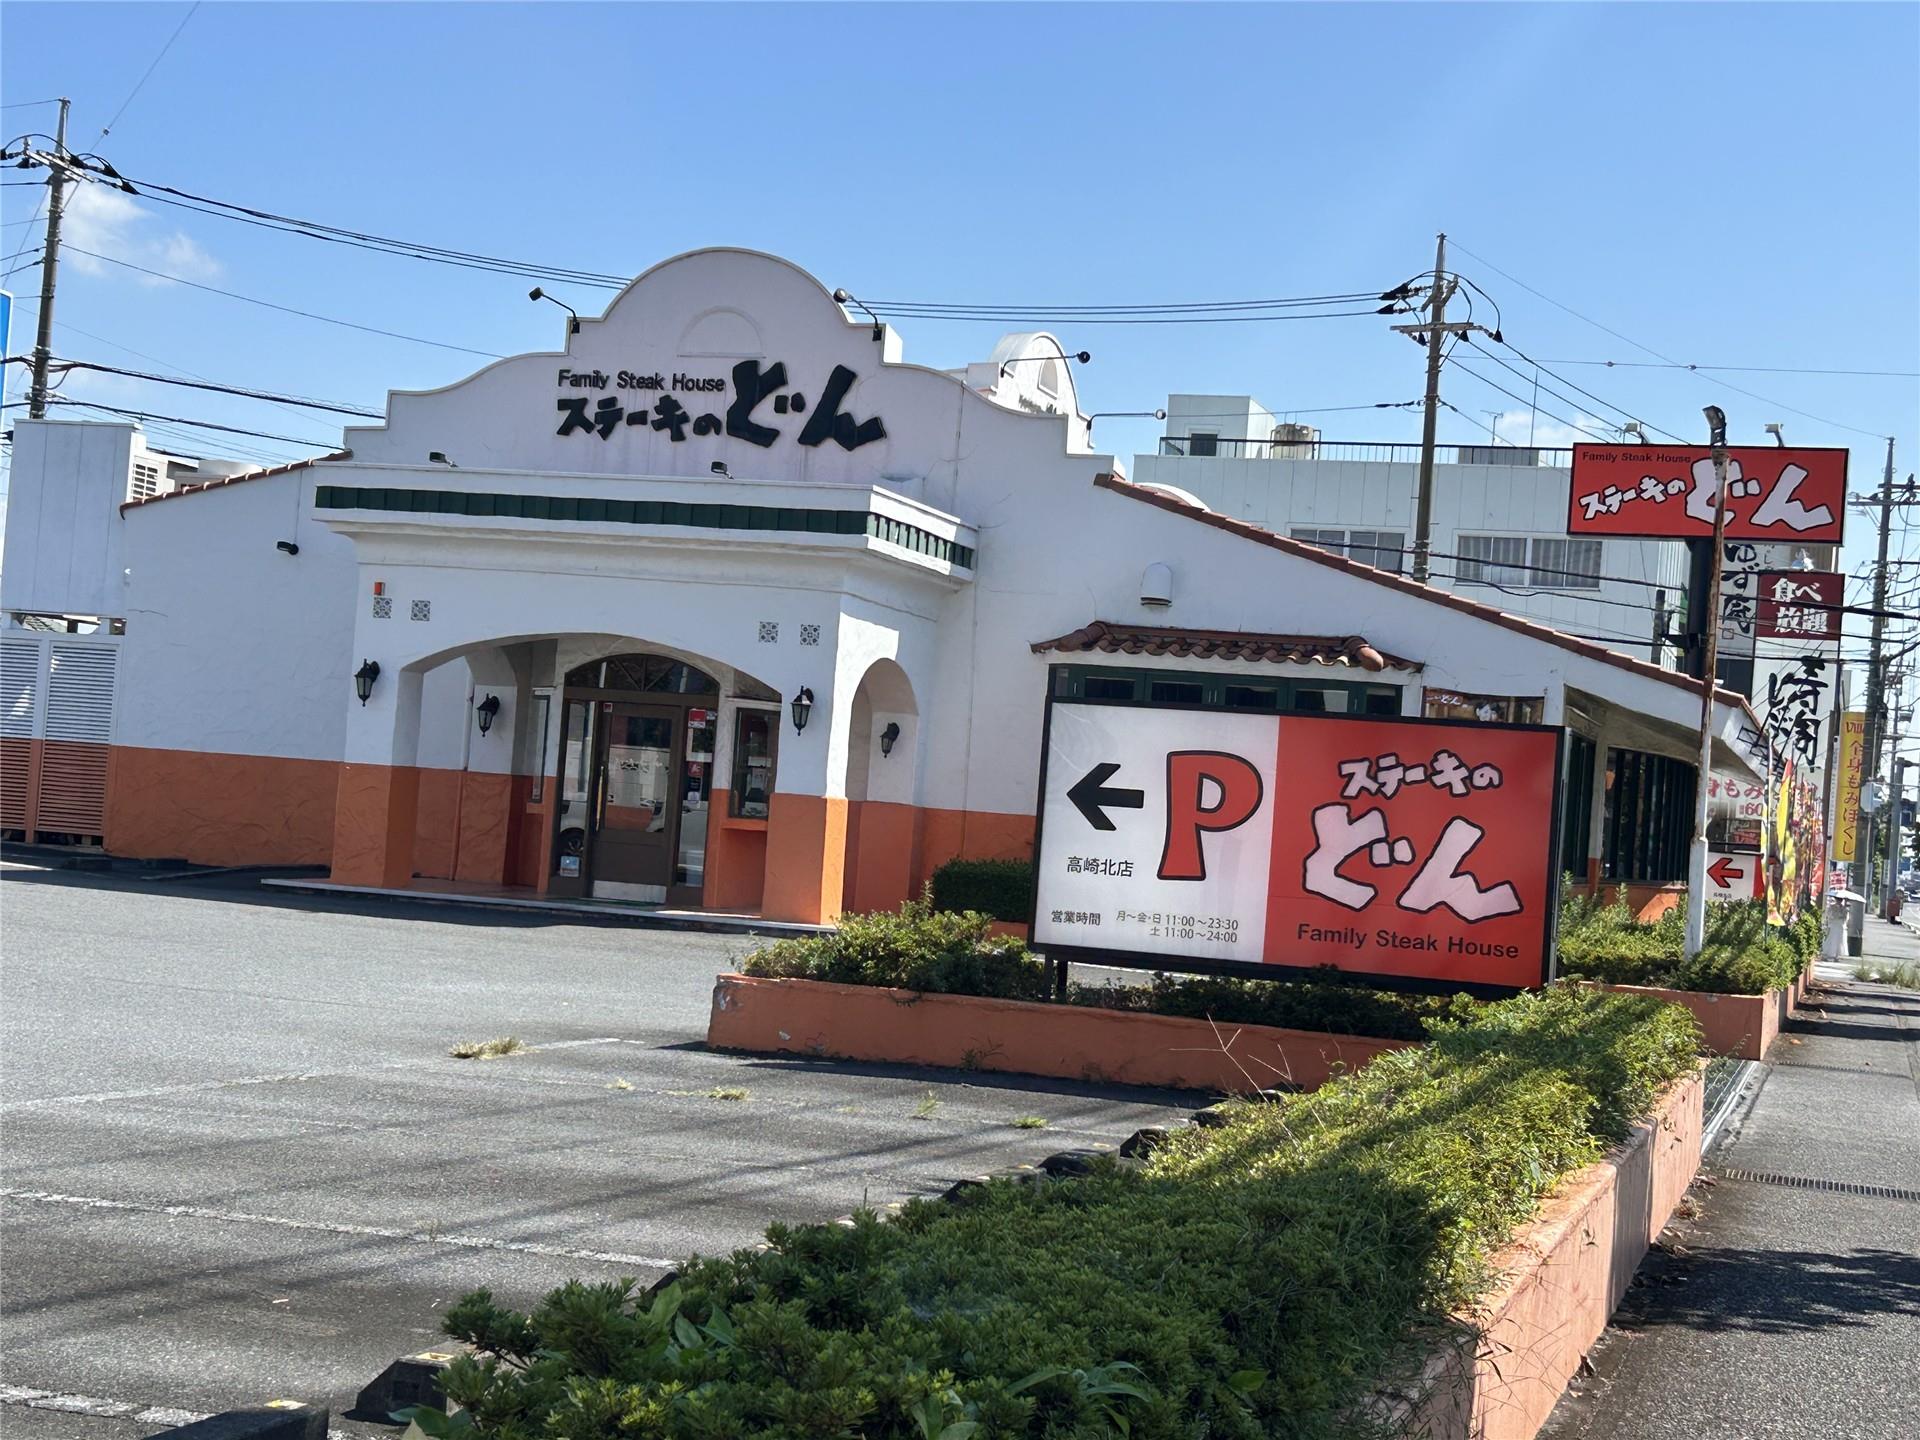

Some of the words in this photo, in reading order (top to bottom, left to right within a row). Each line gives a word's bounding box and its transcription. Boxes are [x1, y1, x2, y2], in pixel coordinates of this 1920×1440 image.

[558, 369, 609, 390] Family
[616, 370, 664, 391] Steak
[672, 373, 725, 392] House
[556, 360, 887, 452] ステーキのどん
[1582, 451, 1618, 462] Family
[1622, 452, 1653, 462] Steak
[1656, 453, 1692, 463] House
[1579, 456, 1835, 533] ステーキのどん
[1771, 577, 1823, 605] 食べ
[1338, 749, 1503, 799] ステーキの
[1157, 750, 1263, 881] P
[1067, 855, 1134, 878] 高崎北店
[1302, 801, 1524, 925] どん
[1051, 910, 1101, 926] 営業時間
[1297, 922, 1367, 949] Family
[1376, 929, 1439, 952] Steak
[1447, 936, 1519, 959] House
